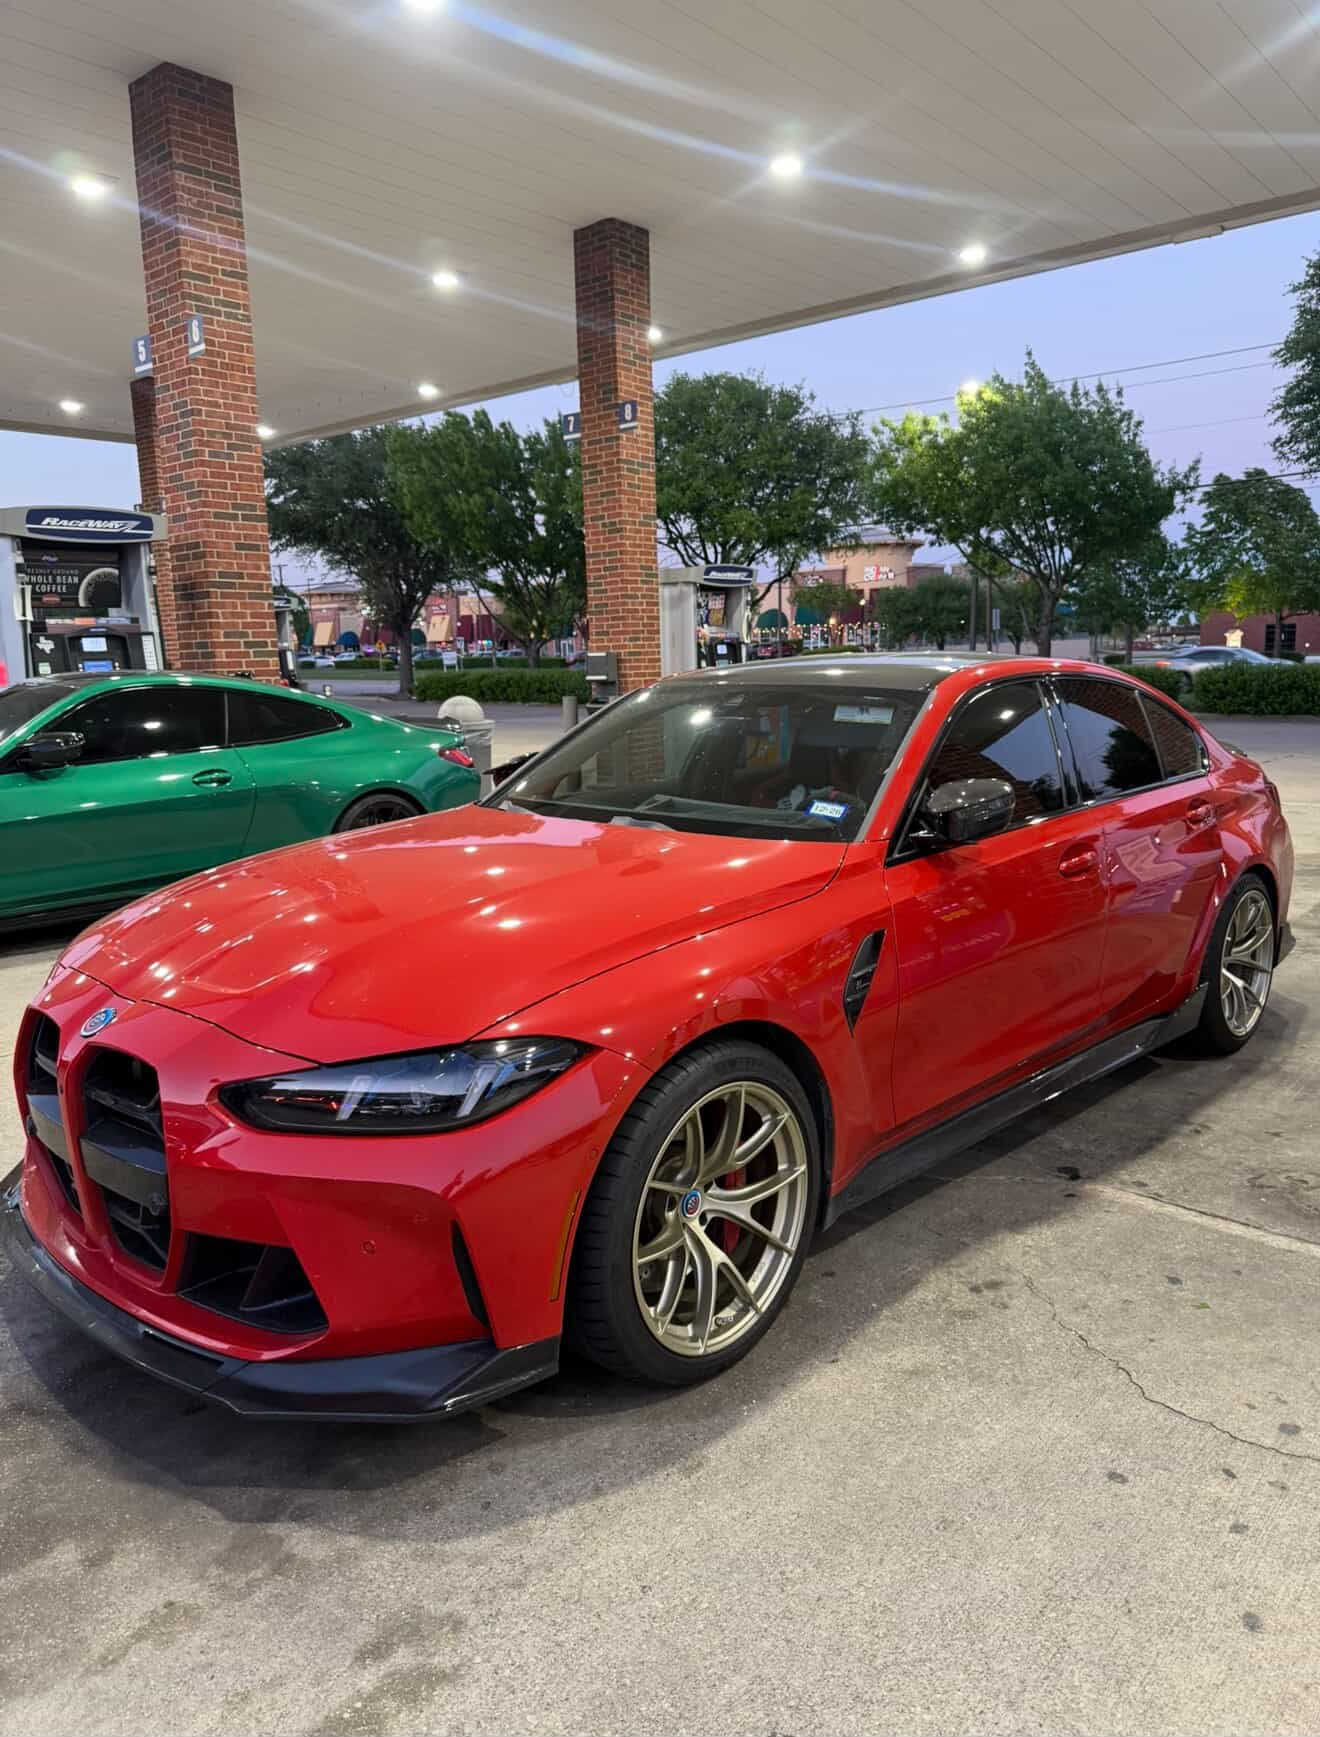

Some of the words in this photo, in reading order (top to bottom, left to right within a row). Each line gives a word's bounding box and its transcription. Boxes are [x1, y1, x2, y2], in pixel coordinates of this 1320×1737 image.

[191, 319, 200, 343] 6
[137, 340, 146, 362] 5
[624, 403, 632, 421] 8
[567, 416, 575, 432] 7
[56, 575, 79, 585] BEAN
